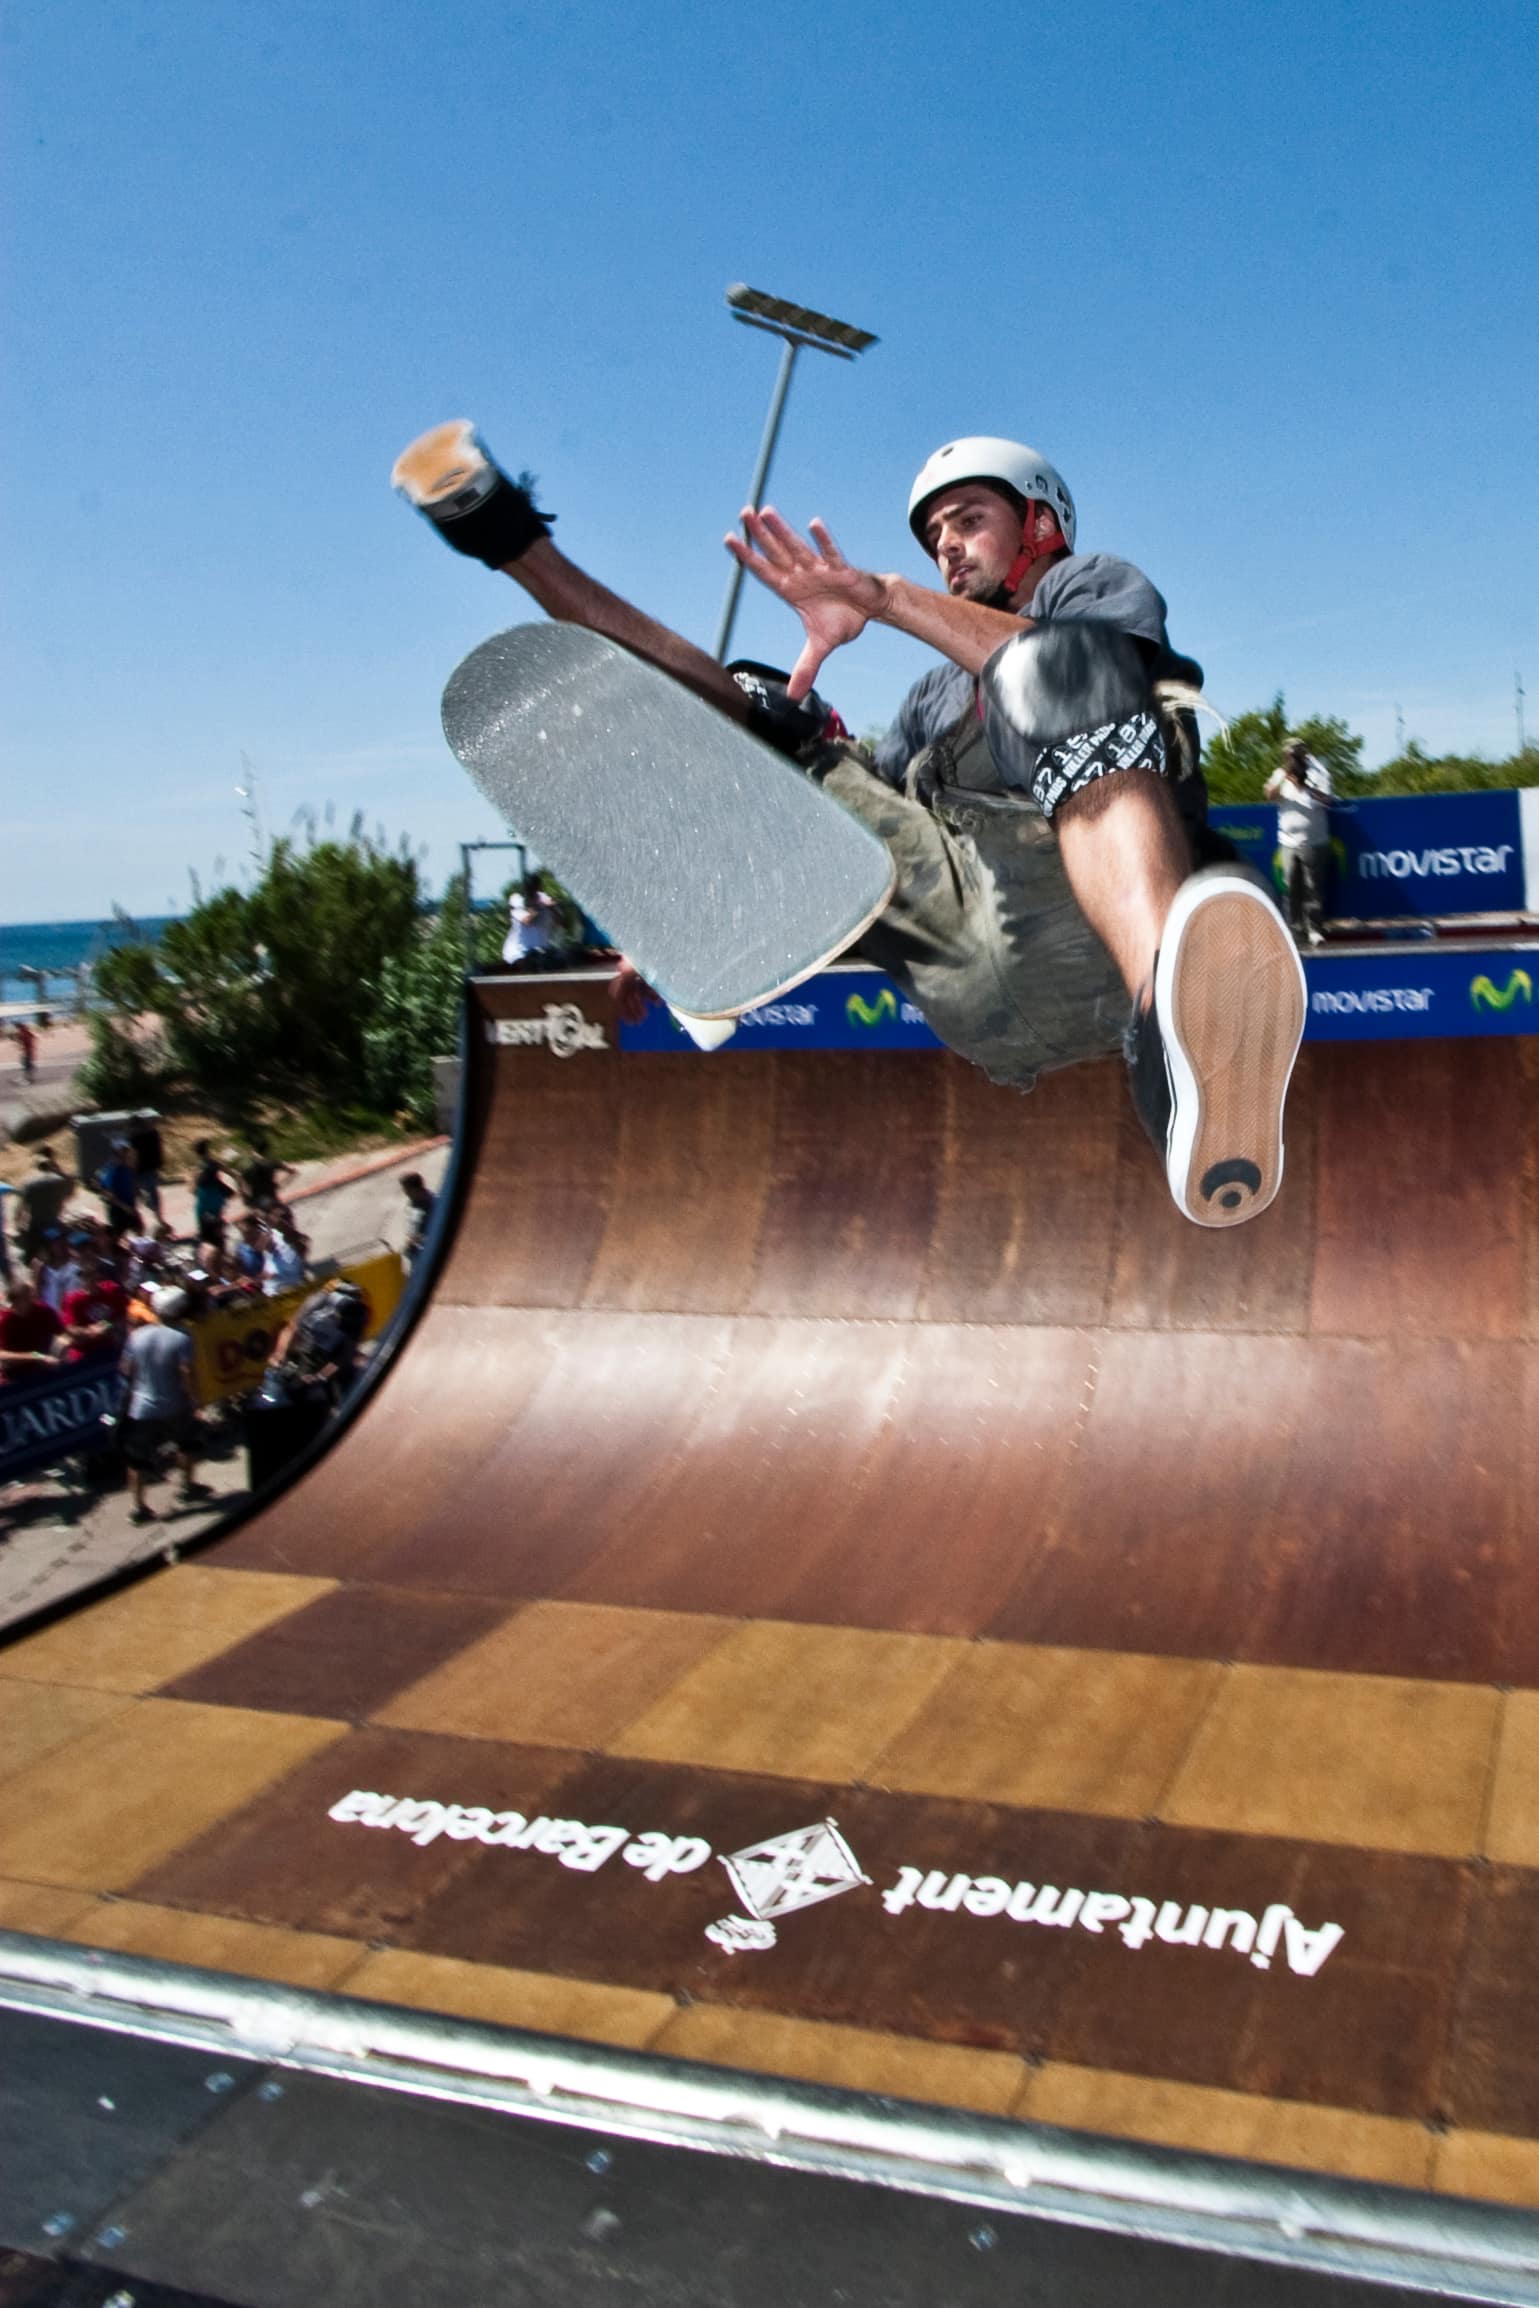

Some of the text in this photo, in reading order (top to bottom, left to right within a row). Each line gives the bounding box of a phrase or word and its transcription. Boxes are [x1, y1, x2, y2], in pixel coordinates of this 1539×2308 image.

[1063, 743, 1096, 779] KILLER
[1358, 845, 1515, 879] movistar
[737, 1004, 819, 1026] ovistar
[1311, 987, 1435, 1014] movistar
[327, 1790, 1345, 1976] Ajuntament de Barcelona
